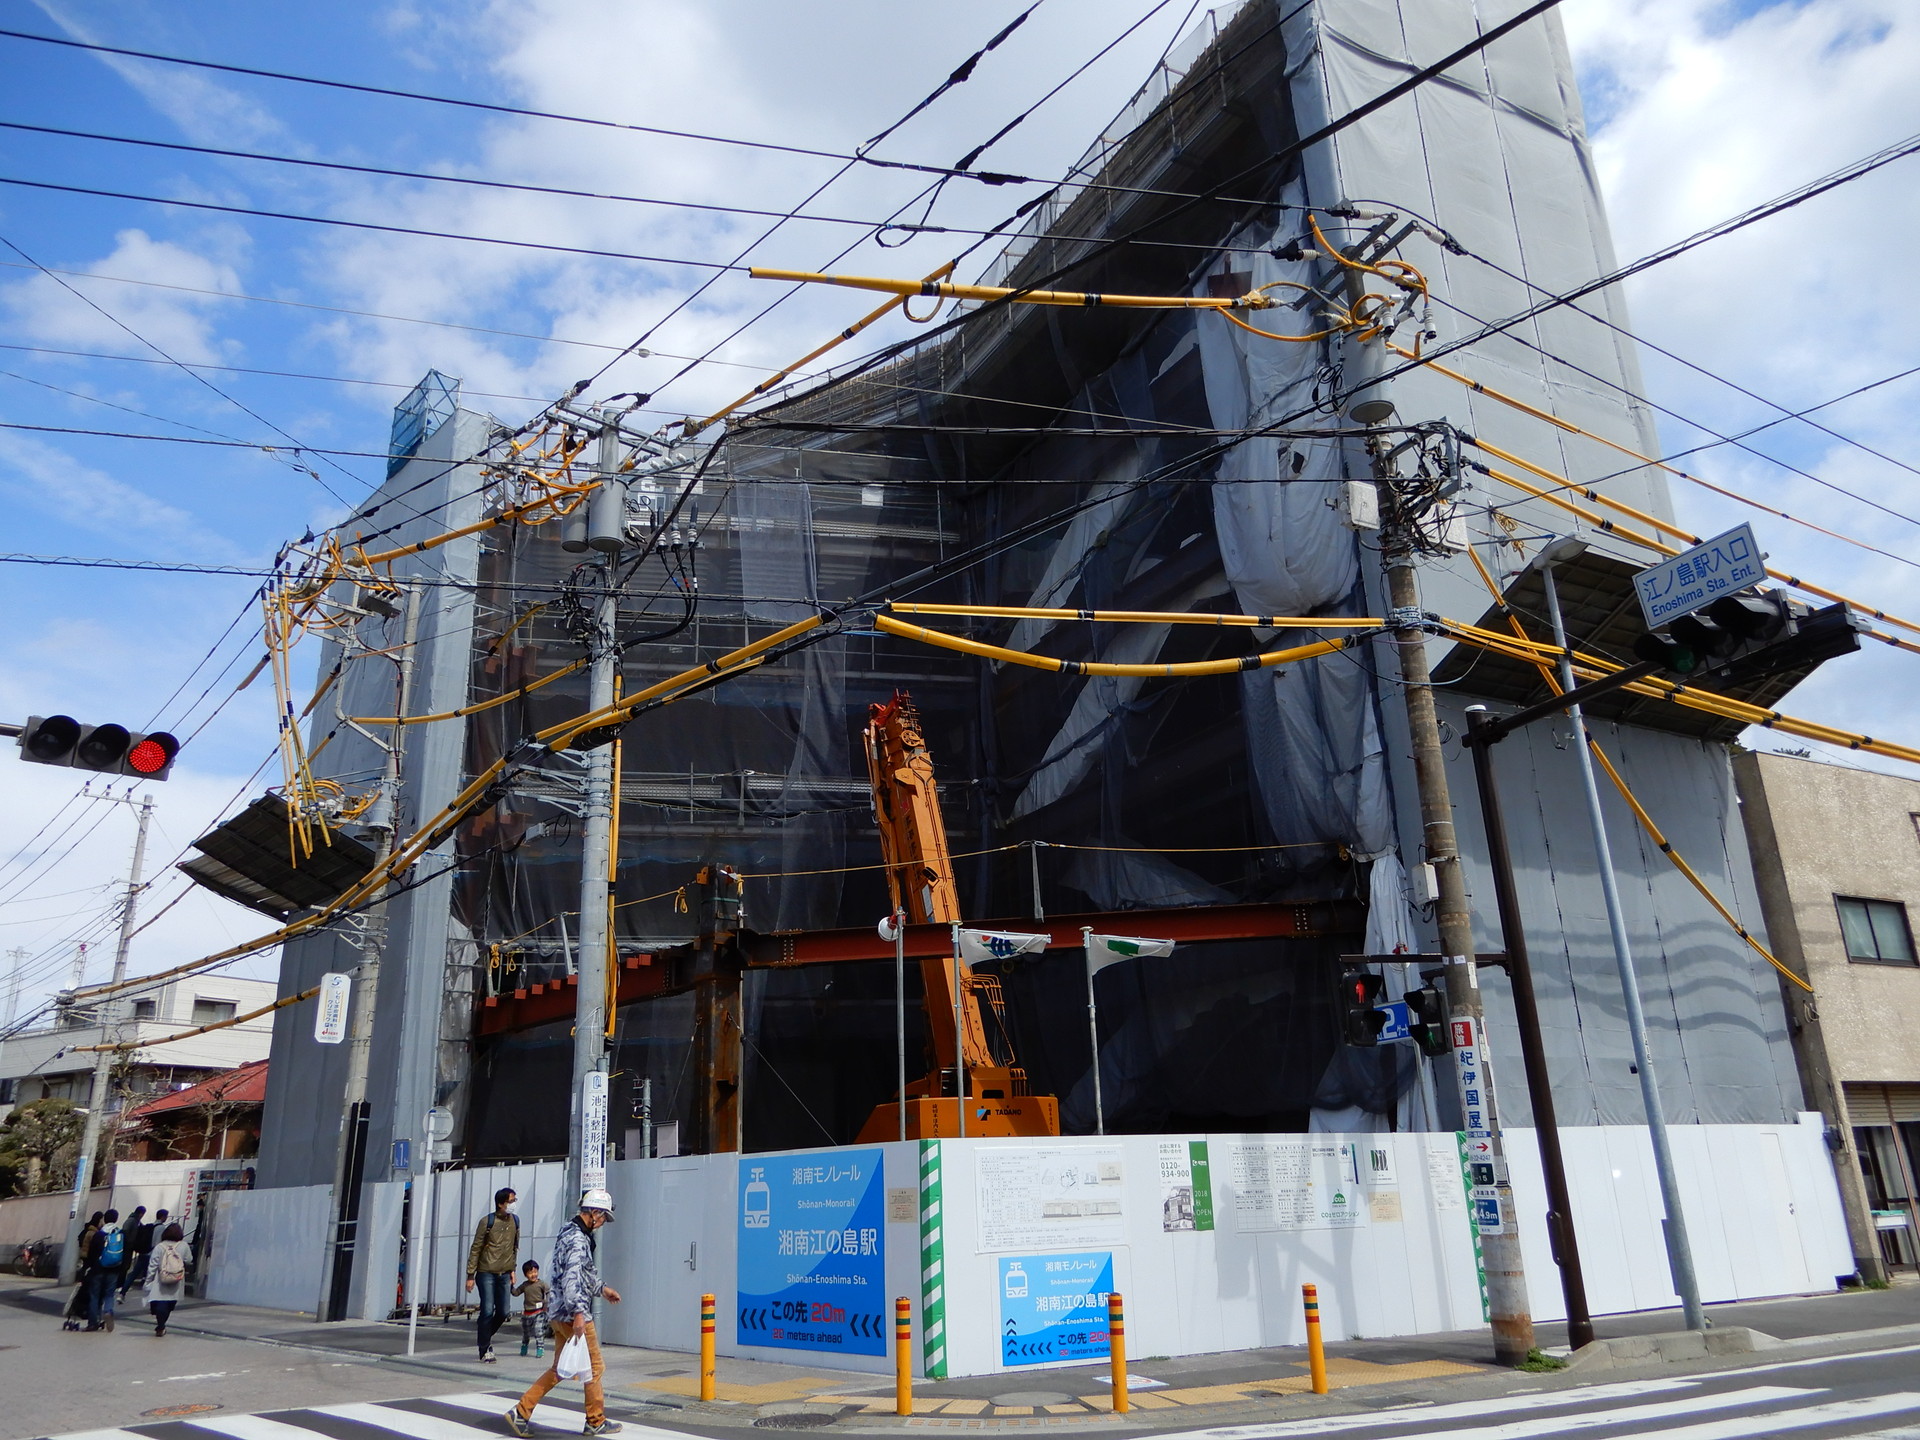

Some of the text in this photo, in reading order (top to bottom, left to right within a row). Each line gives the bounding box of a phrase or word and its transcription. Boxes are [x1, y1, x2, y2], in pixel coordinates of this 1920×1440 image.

[1643, 536, 1750, 602] 江ノ島駅入口
[1651, 565, 1756, 617] Enoshima Sta. Ent.
[1460, 1050, 1483, 1128] 紀伊国屋
[590, 1095, 602, 1168] 池上整形外科
[792, 1165, 861, 1185] 湘南モノレール
[778, 1228, 878, 1256] 湘南江の島駅
[1045, 1260, 1097, 1272] 湘南モノレール
[853, 1275, 868, 1285] Sta.
[772, 1301, 846, 1323] この先 20m
[1036, 1292, 1110, 1312] 湘南江の島駅
[772, 1328, 843, 1344] 20 meters ahead
[1058, 1333, 1087, 1345] この先
